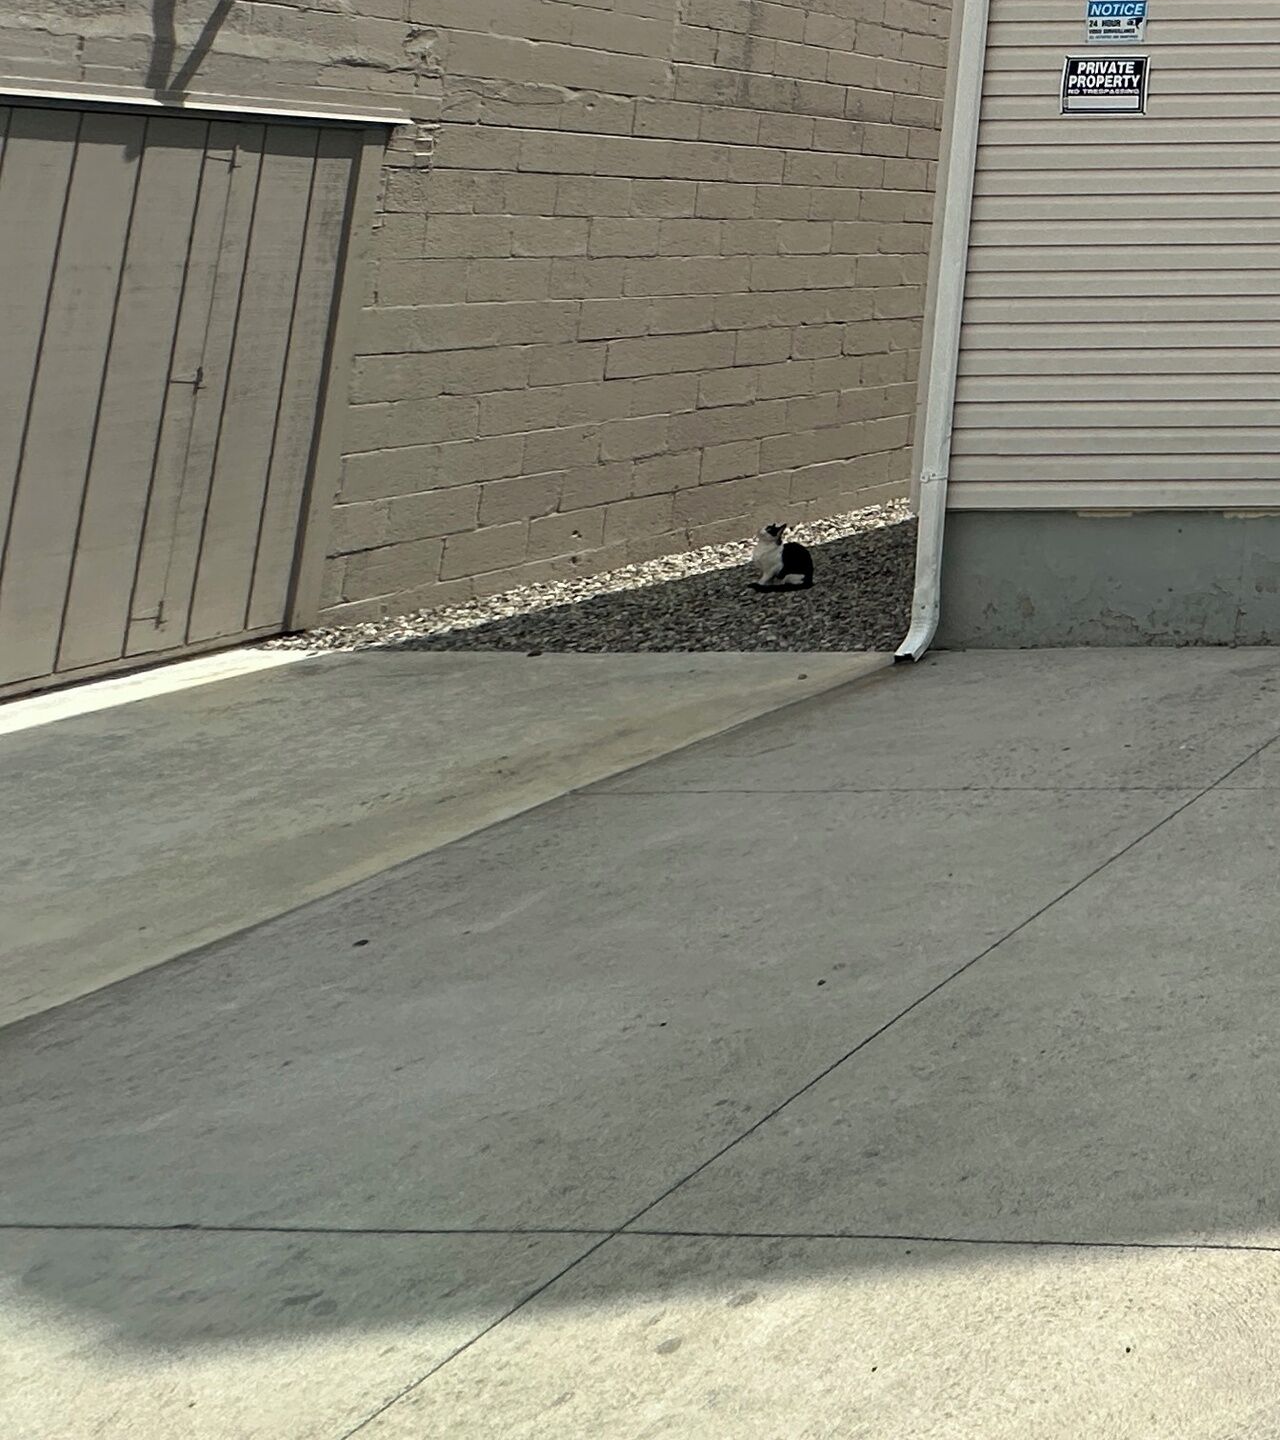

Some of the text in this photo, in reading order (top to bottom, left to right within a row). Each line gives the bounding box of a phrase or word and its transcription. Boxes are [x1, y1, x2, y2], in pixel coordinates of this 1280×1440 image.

[1090, 3, 1144, 16] NOTICE
[1077, 61, 1135, 74] PRIVATE
[1068, 75, 1141, 88] PROPERTY
